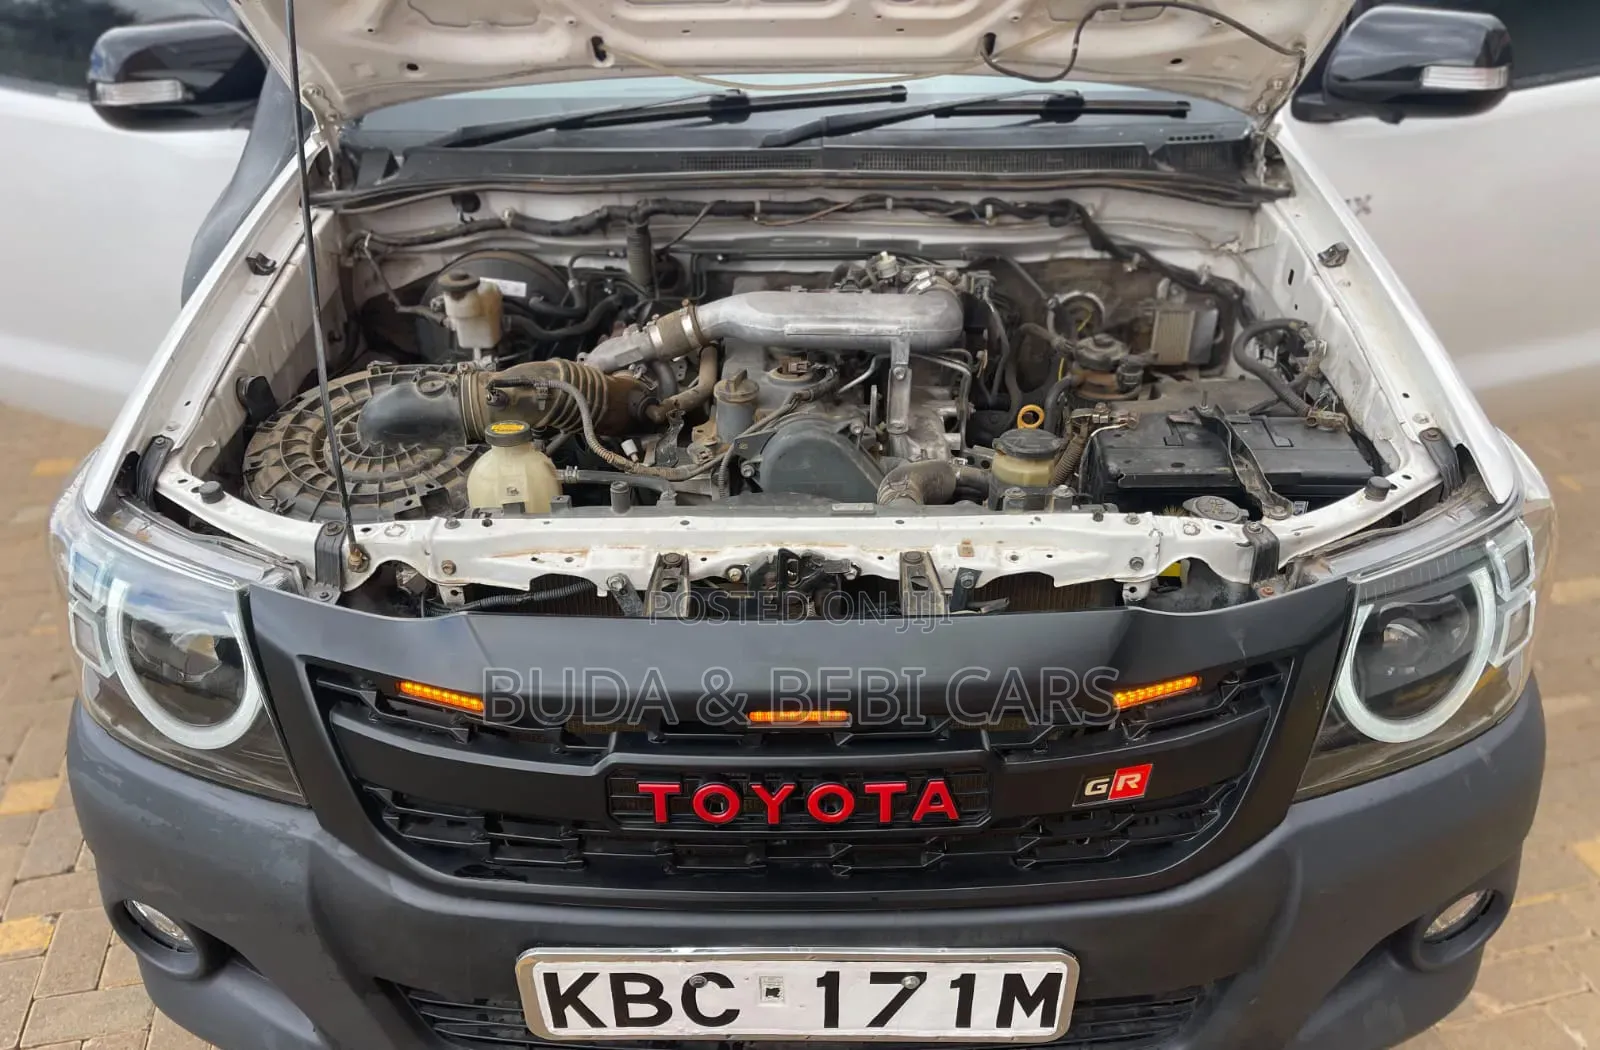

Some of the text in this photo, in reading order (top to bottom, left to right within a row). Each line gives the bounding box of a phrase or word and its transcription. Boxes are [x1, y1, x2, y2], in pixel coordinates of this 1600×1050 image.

[638, 779, 960, 825] TOYOTA
[1083, 772, 1142, 797] GR
[542, 970, 1063, 1029] KBC 171M
